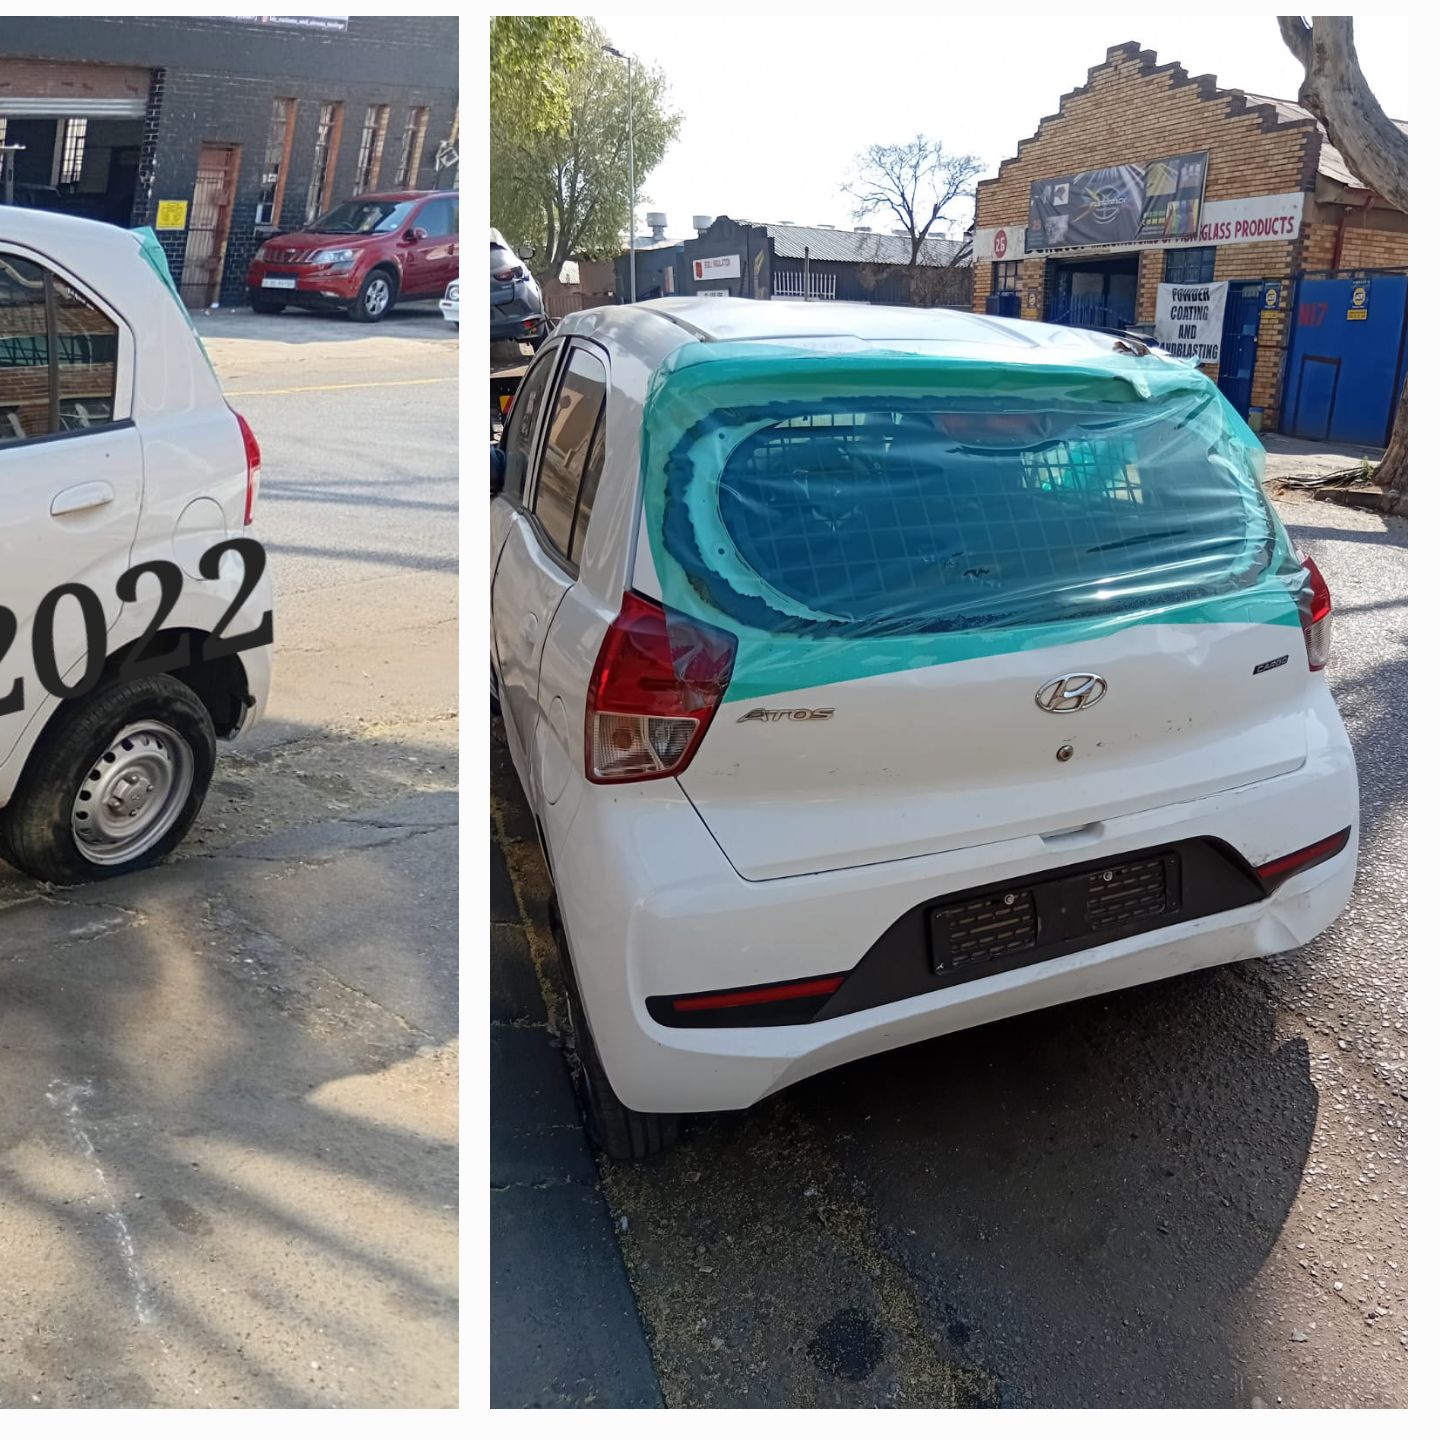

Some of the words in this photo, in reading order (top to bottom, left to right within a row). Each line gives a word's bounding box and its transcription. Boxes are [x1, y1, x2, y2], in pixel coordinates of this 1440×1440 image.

[1234, 216, 1295, 239] PRODUCTS
[1171, 287, 1211, 302] POWDER
[1170, 305, 1209, 321] COATING
[1178, 324, 1198, 340] AND
[1159, 342, 1219, 360] ANDBLASTING
